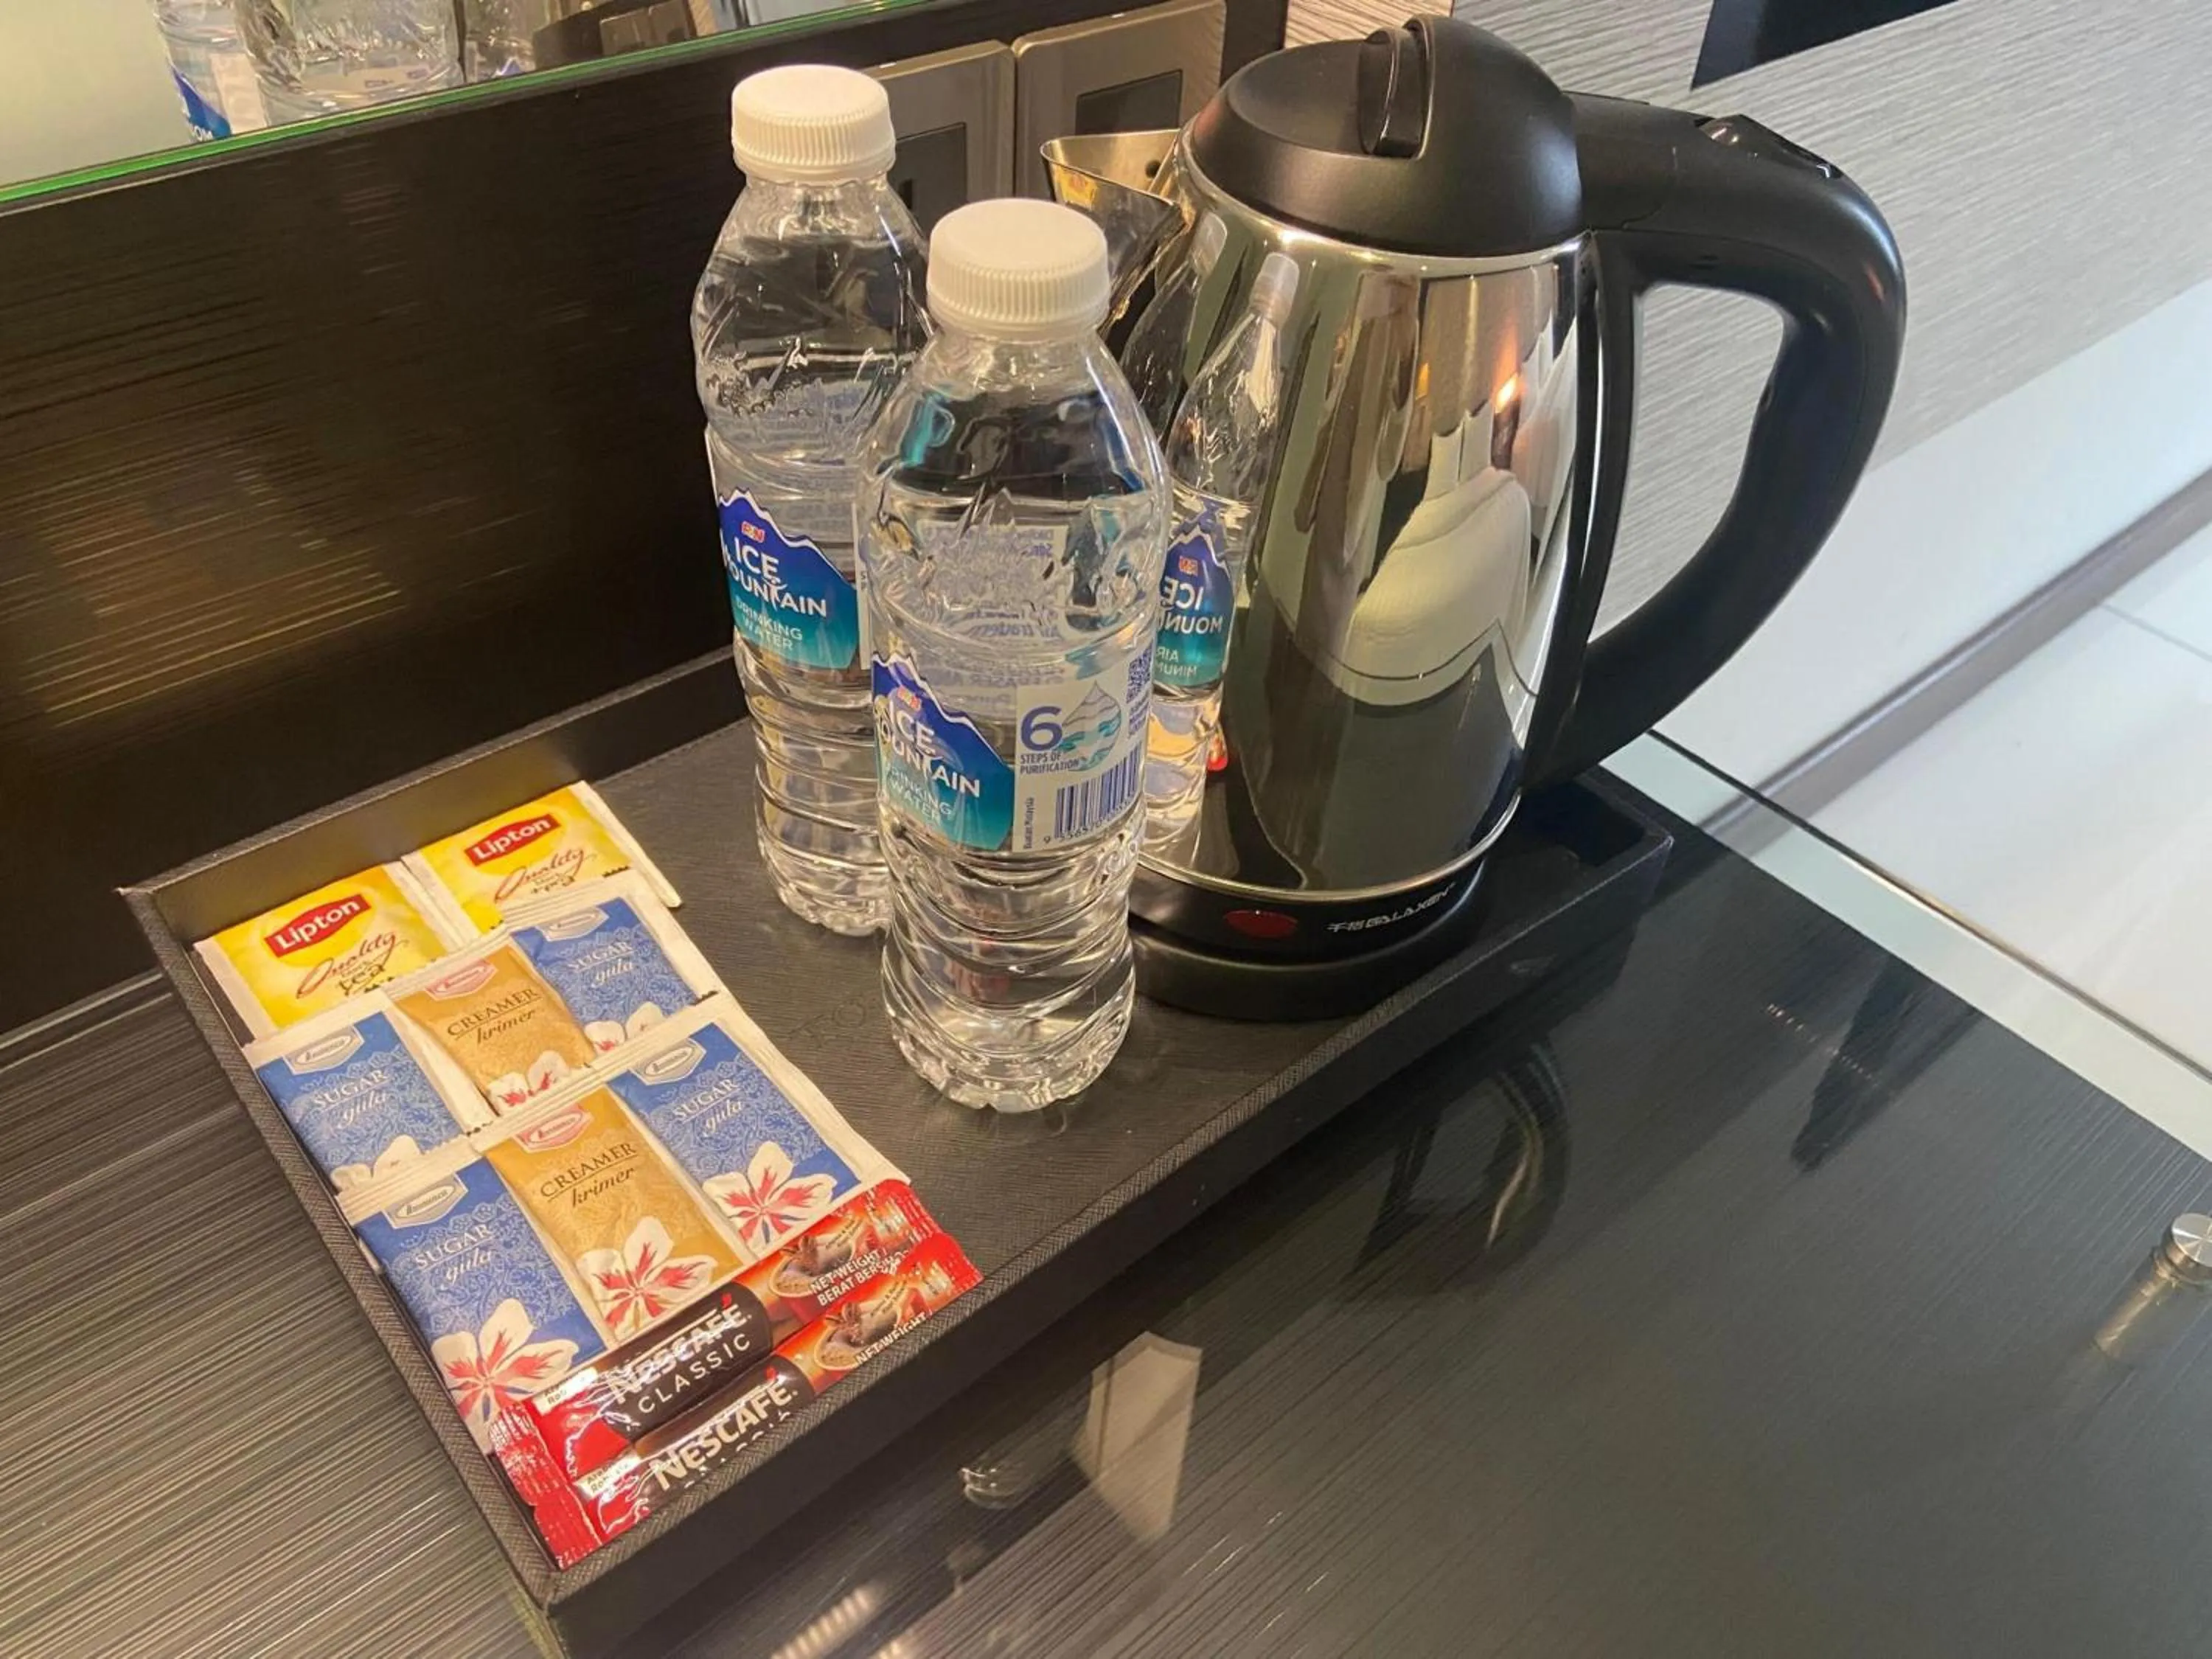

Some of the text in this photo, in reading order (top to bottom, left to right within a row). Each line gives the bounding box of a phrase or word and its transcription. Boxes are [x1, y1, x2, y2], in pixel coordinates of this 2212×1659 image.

[734, 537, 780, 581] ICE
[888, 699, 935, 754] ICE
[1020, 706, 1062, 751] 6
[1020, 753, 1048, 765] STEPS
[1020, 758, 1079, 774] PURIFICATION
[472, 818, 552, 860] Lipton
[494, 849, 594, 904] Quality
[274, 900, 361, 949] Lipton
[296, 931, 408, 999] Quality
[567, 941, 634, 970] SUGAR
[447, 988, 538, 1036] CREAMER
[476, 1009, 536, 1044] krimer
[314, 1069, 389, 1107] SUGAR
[673, 1079, 740, 1119] SUGAR
[540, 1142, 637, 1197] CREAMER
[571, 1167, 635, 1208] krimer
[415, 1224, 495, 1269] SUGAR
[817, 1276, 856, 1307] BERAT
[638, 1333, 751, 1414] CLASSIC
